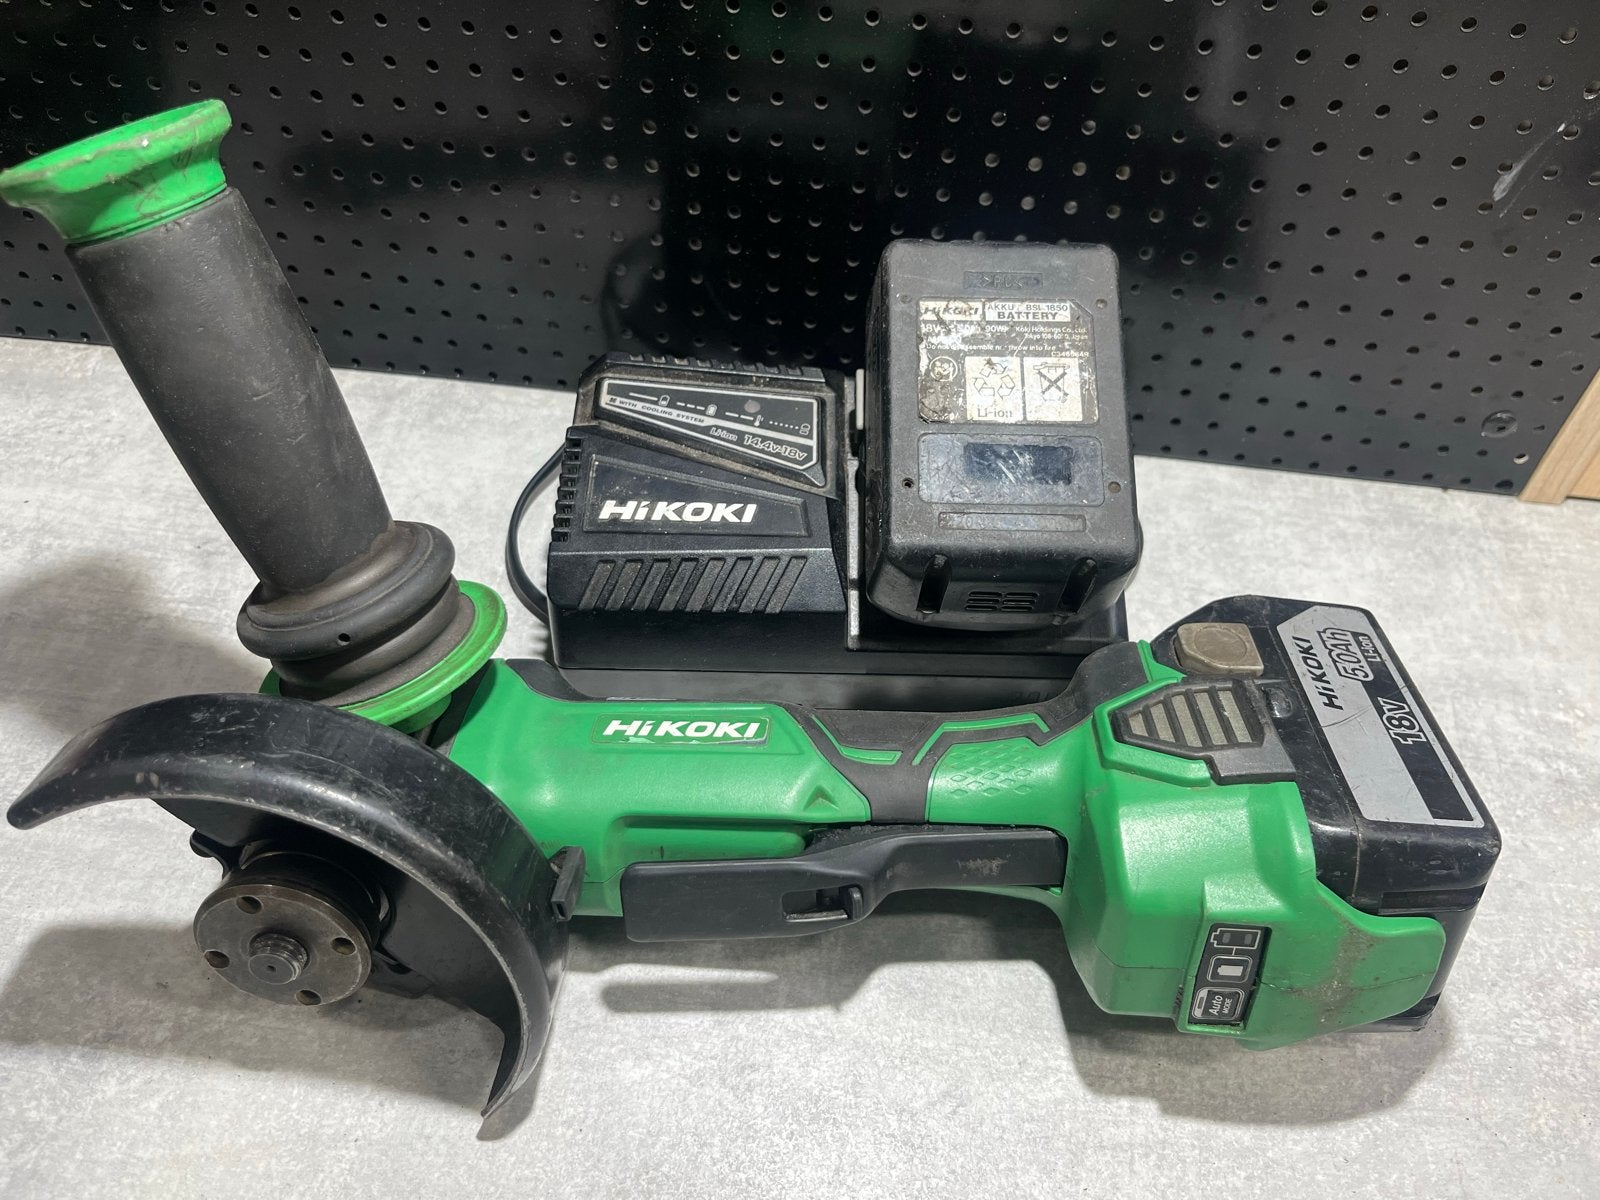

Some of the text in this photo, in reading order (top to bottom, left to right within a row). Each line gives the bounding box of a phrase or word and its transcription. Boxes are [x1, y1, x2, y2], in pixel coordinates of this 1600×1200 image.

[987, 303, 1014, 311] AKKU
[1046, 304, 1068, 312] 1850
[997, 311, 1058, 320] BATTERY
[619, 400, 705, 424] WITH COOLING SYSTEM
[599, 500, 757, 523] HiKOKI
[1320, 627, 1373, 681] 5.0Ah
[1359, 635, 1382, 663] Li-ion
[1292, 635, 1344, 712] HiKOKI
[602, 719, 761, 738] HiKOKI
[1377, 696, 1428, 744] 18V
[1208, 995, 1223, 1016] Auto
[1222, 998, 1233, 1014] MODE
